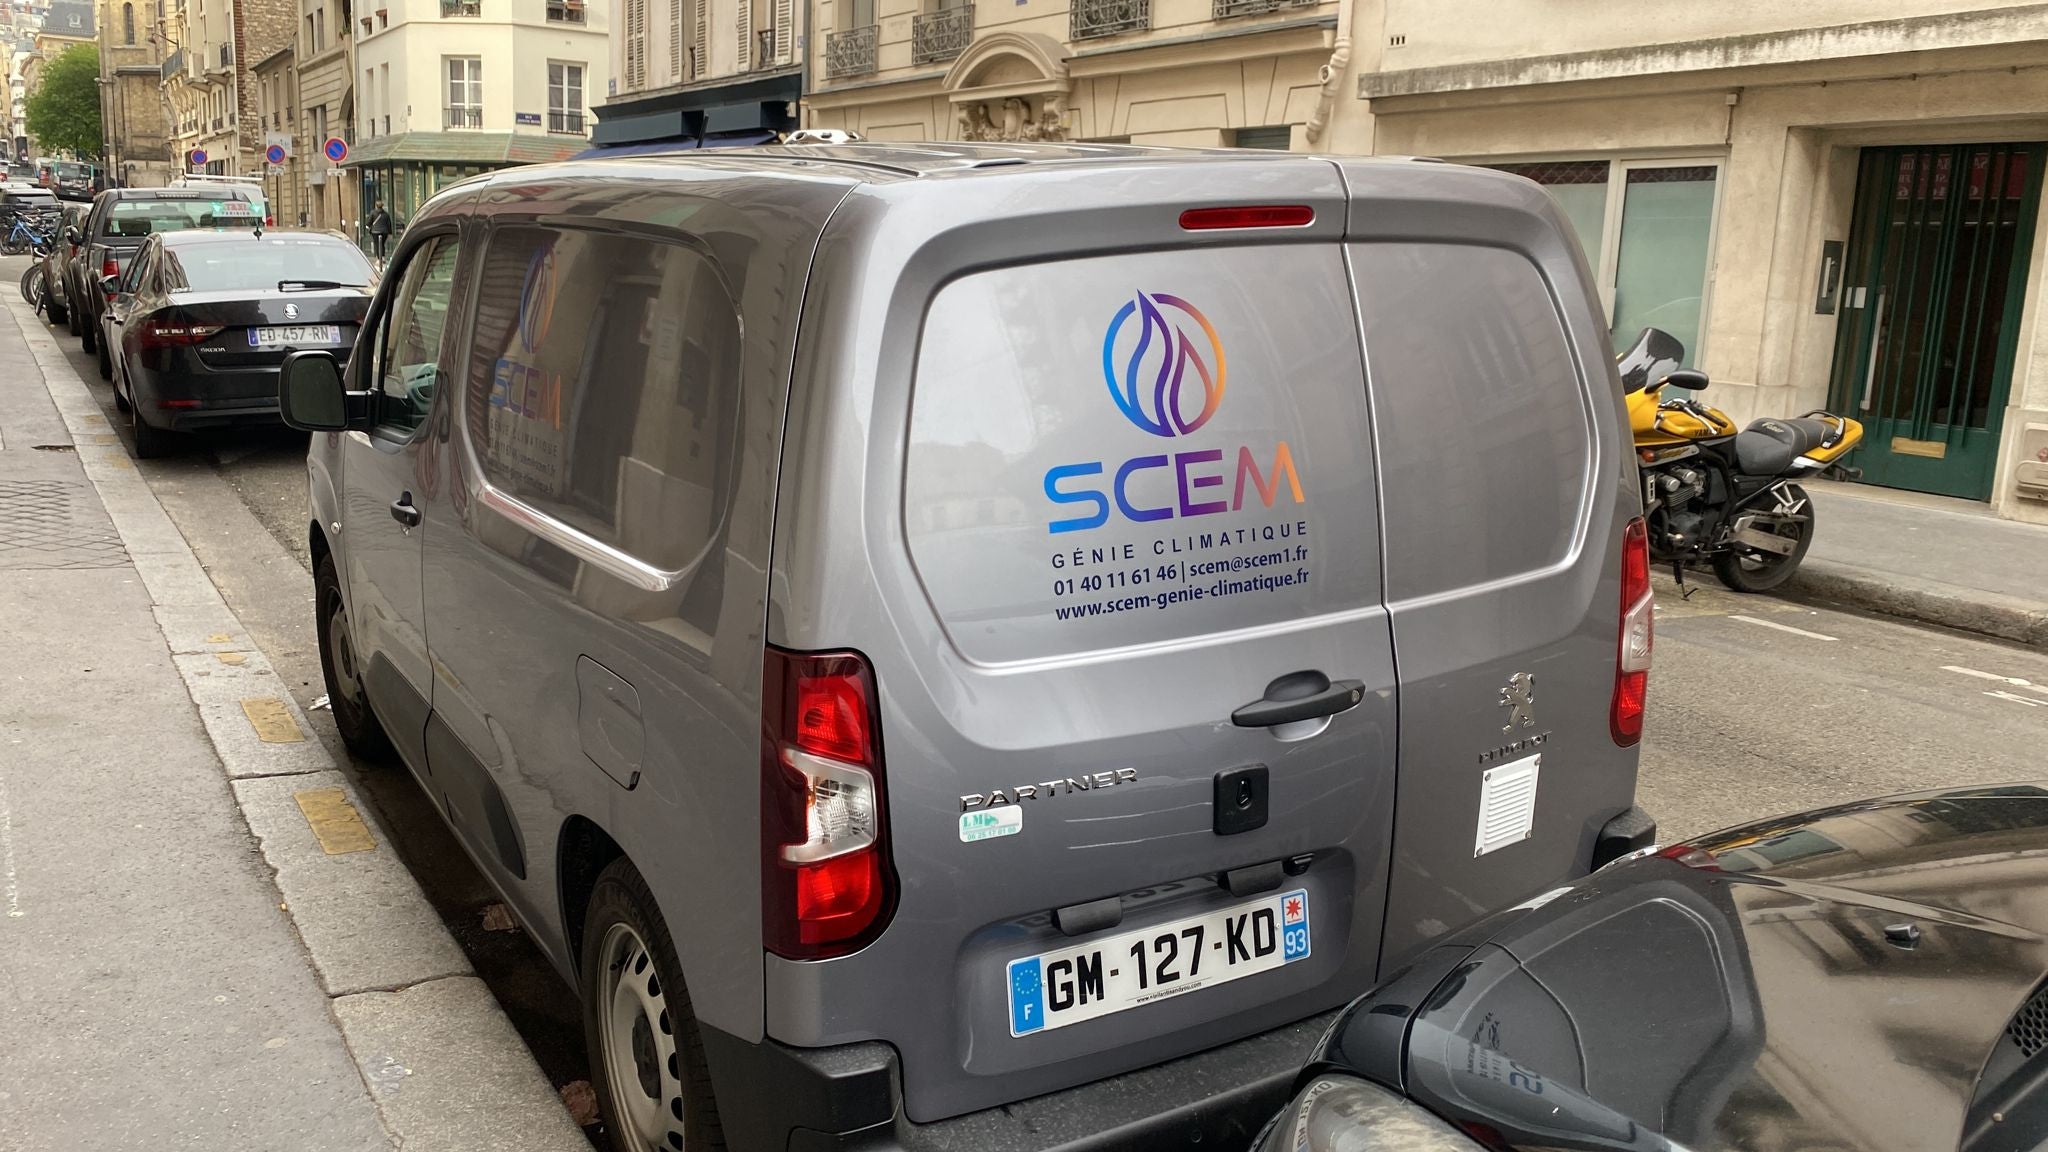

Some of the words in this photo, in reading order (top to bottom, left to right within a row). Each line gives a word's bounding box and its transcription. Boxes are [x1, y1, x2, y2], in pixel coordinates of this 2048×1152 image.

[224, 203, 247, 211] TAXI
[258, 326, 329, 342] ED-457-RN
[1043, 440, 1305, 534] SCEM
[1052, 544, 1135, 569] GÉNIE
[1153, 520, 1307, 555] CLIMATIQUE
[1053, 579, 1075, 596] 01
[1080, 575, 1102, 592] 40
[1107, 571, 1126, 589] 11
[1131, 568, 1151, 585] 61
[1156, 564, 1177, 582] 46
[1189, 545, 1308, 577] scem@scem1.fr
[1055, 568, 1309, 621] www.scem-genie-climatique.fr
[959, 767, 1138, 812] PARTNER
[1046, 906, 1277, 1013] GM-127-KD
[1285, 928, 1307, 955] 93
[1023, 1003, 1034, 1021] F
